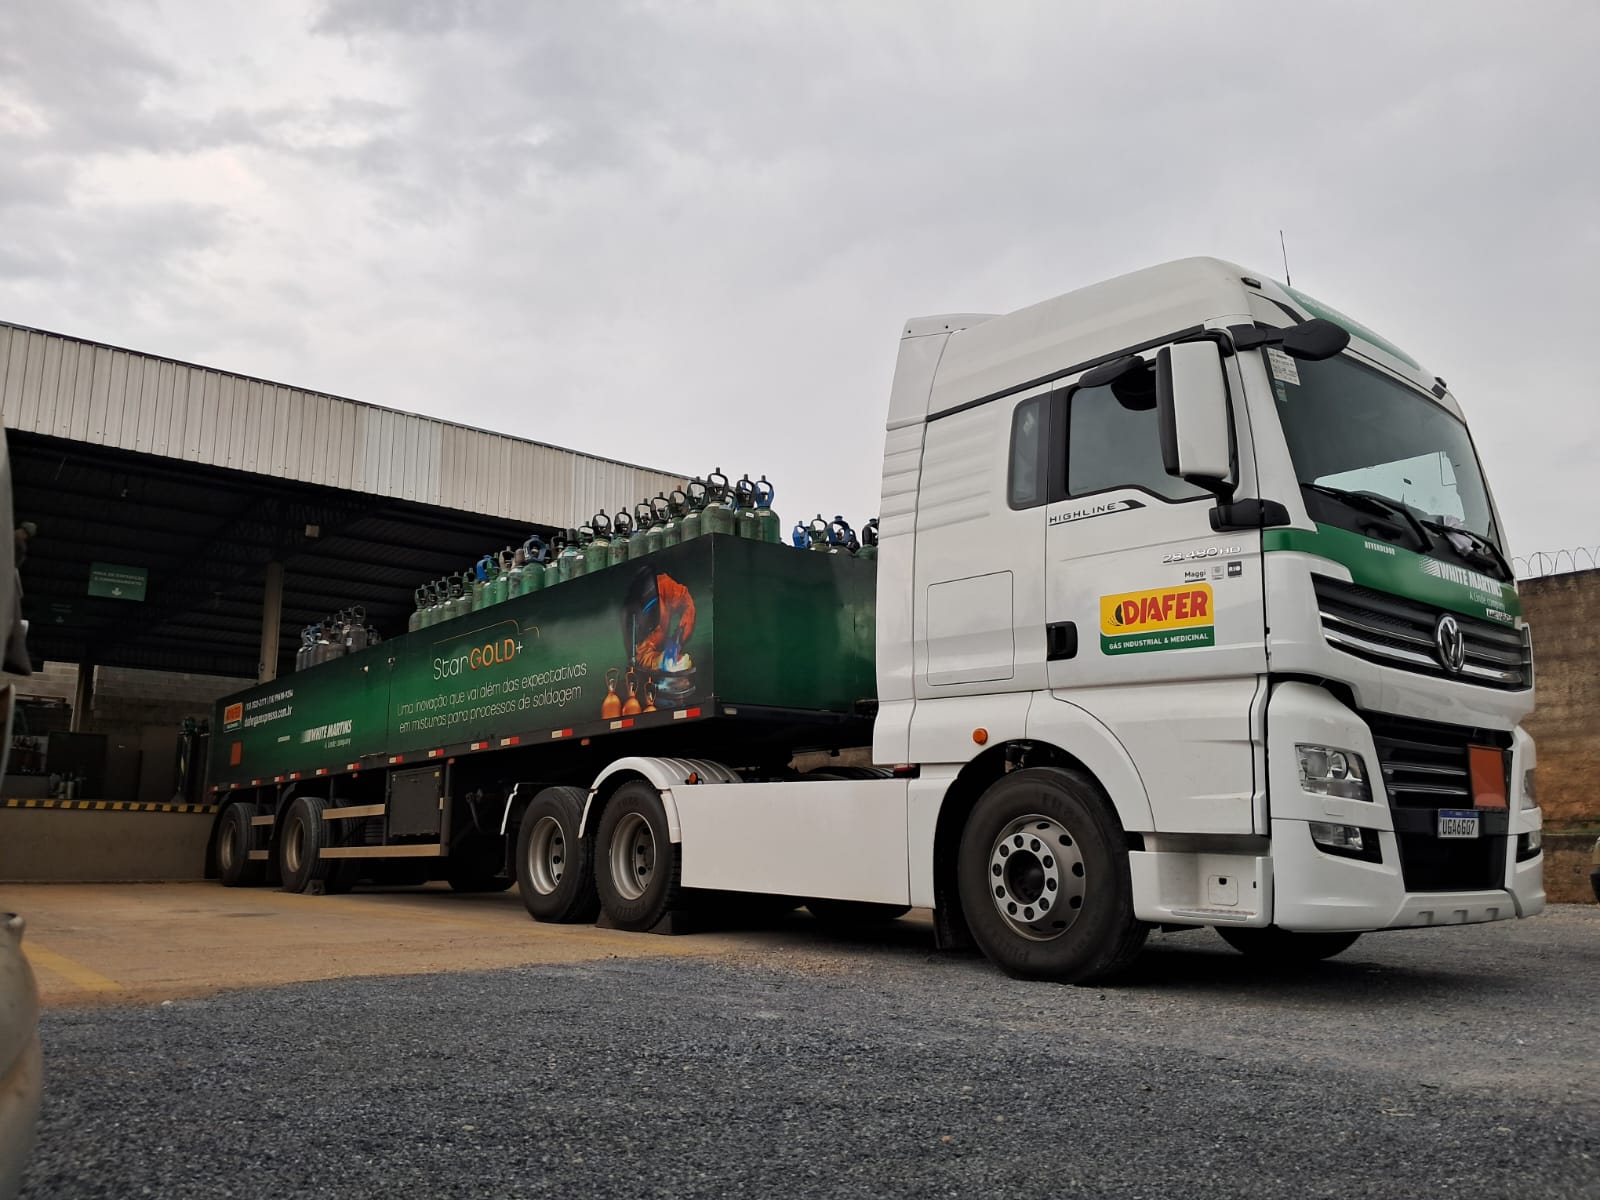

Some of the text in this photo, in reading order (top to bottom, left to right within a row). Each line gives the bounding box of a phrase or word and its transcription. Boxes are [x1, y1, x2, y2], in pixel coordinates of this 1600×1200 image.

[1050, 502, 1116, 524] HIGHLINE
[1184, 569, 1207, 580] Maggi
[1439, 562, 1503, 597] WHITE MARTINS
[1122, 590, 1208, 626] DIAFER
[1123, 637, 1162, 649] INDUSTRIAL
[1164, 636, 1169, 645] &
[1170, 633, 1209, 644] MEDICINAL
[397, 662, 588, 717] Uma inovação que vai além das expectativas
[399, 685, 583, 734] em misturas para processos de soldagem
